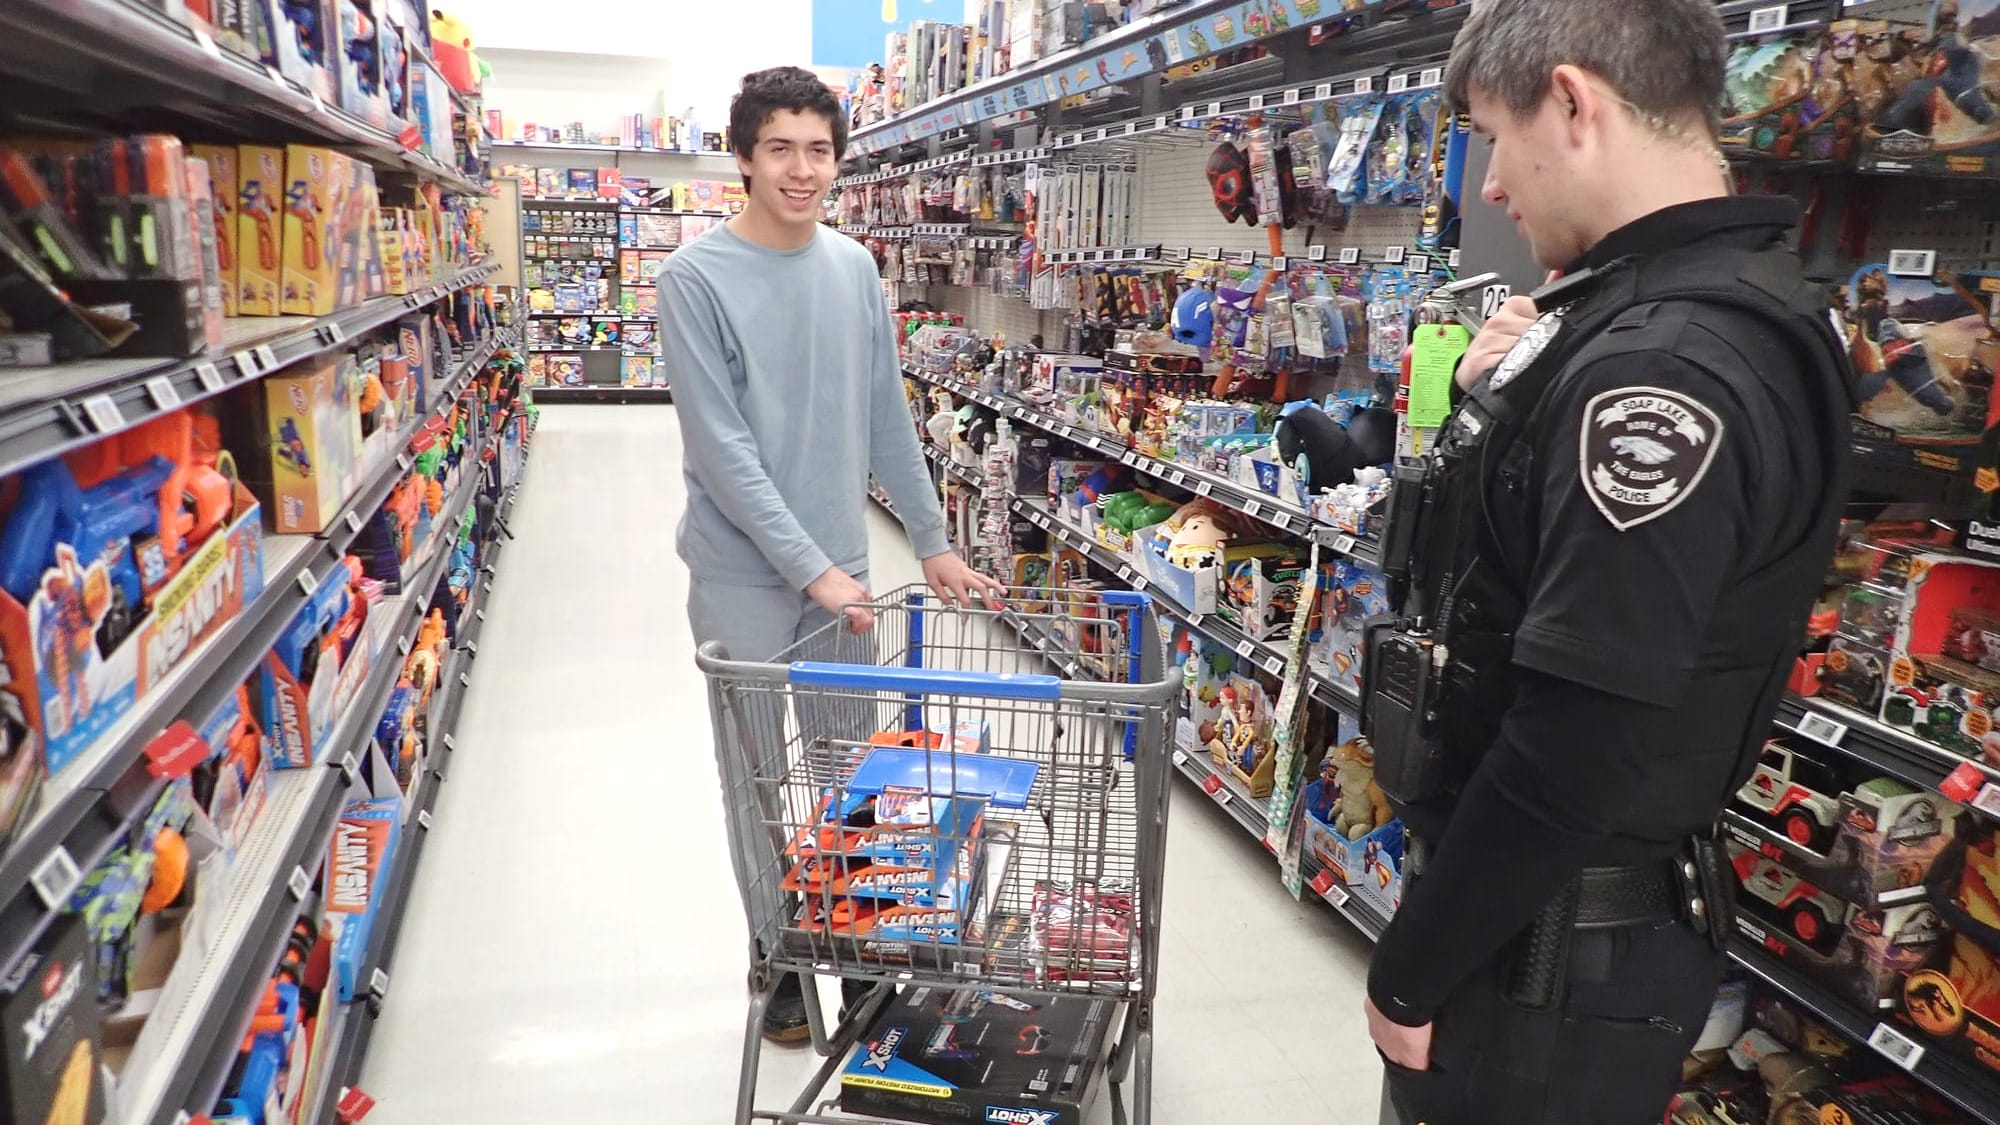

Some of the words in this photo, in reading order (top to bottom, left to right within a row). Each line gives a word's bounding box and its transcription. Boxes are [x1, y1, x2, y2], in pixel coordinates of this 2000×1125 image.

[1621, 399, 1652, 412] SOAP
[1657, 400, 1688, 423] LAKE
[1626, 420, 1657, 432] HOME
[1657, 425, 1674, 437] OF
[1609, 460, 1630, 477] THE
[1628, 470, 1665, 481] EAGLES
[1608, 485, 1650, 502] POLICE
[275, 677, 306, 764] INSANITY
[333, 821, 368, 906] INSANITY
[849, 871, 929, 889] INSANITY
